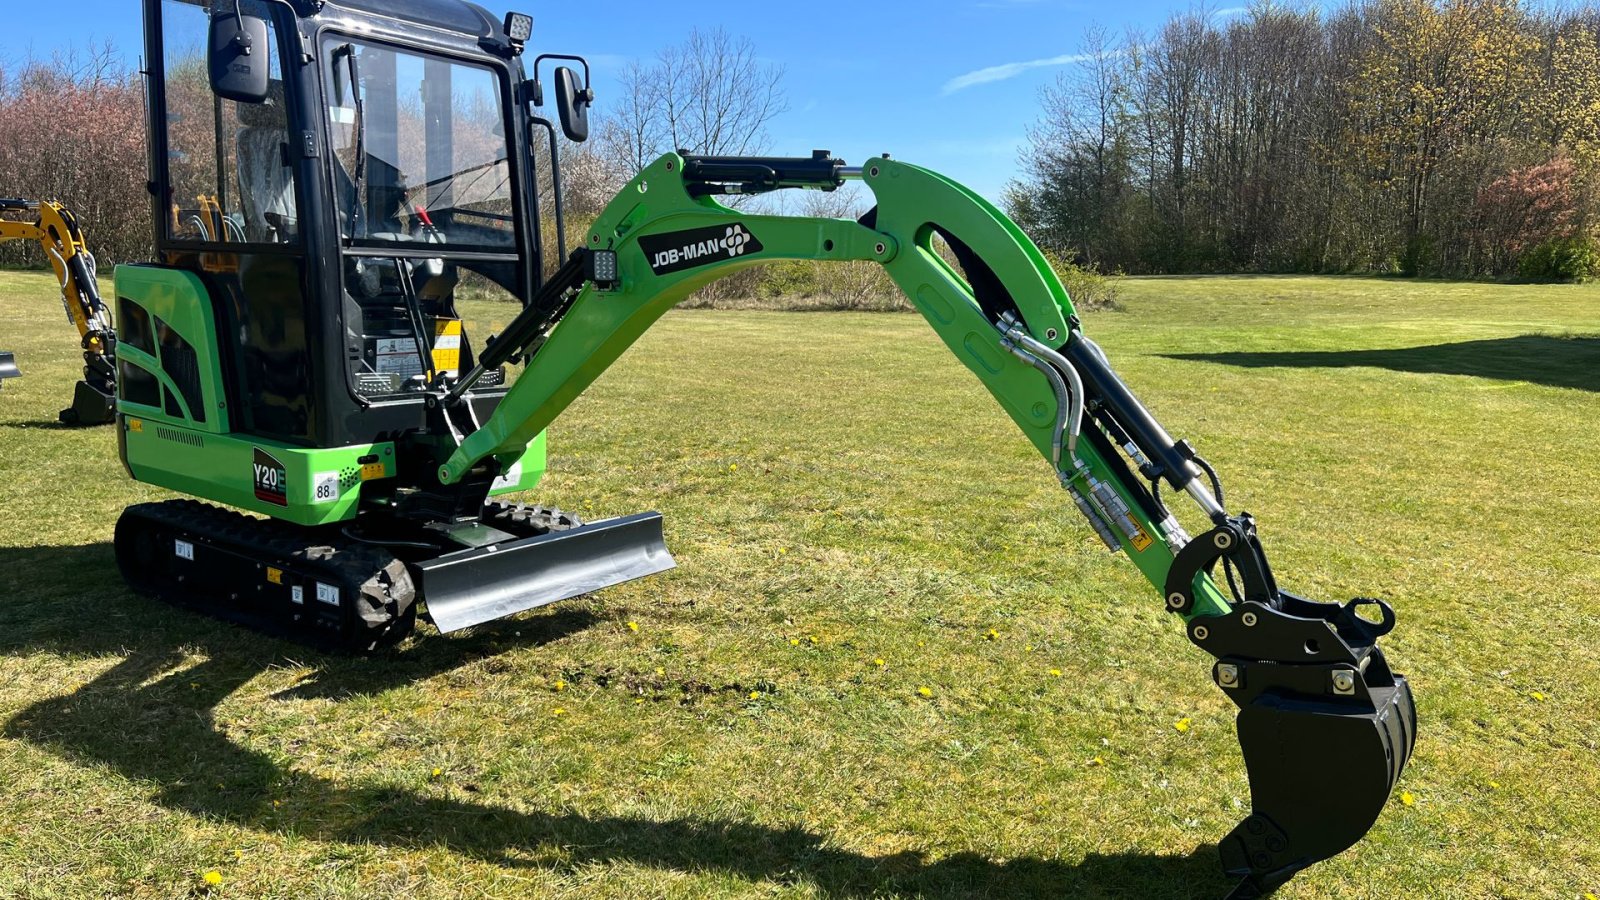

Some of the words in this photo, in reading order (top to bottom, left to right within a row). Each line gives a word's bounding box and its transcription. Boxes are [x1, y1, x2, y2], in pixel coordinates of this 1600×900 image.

[652, 238, 719, 268] JOB-MAN
[253, 463, 285, 488] Y20E
[317, 485, 330, 498] 88
